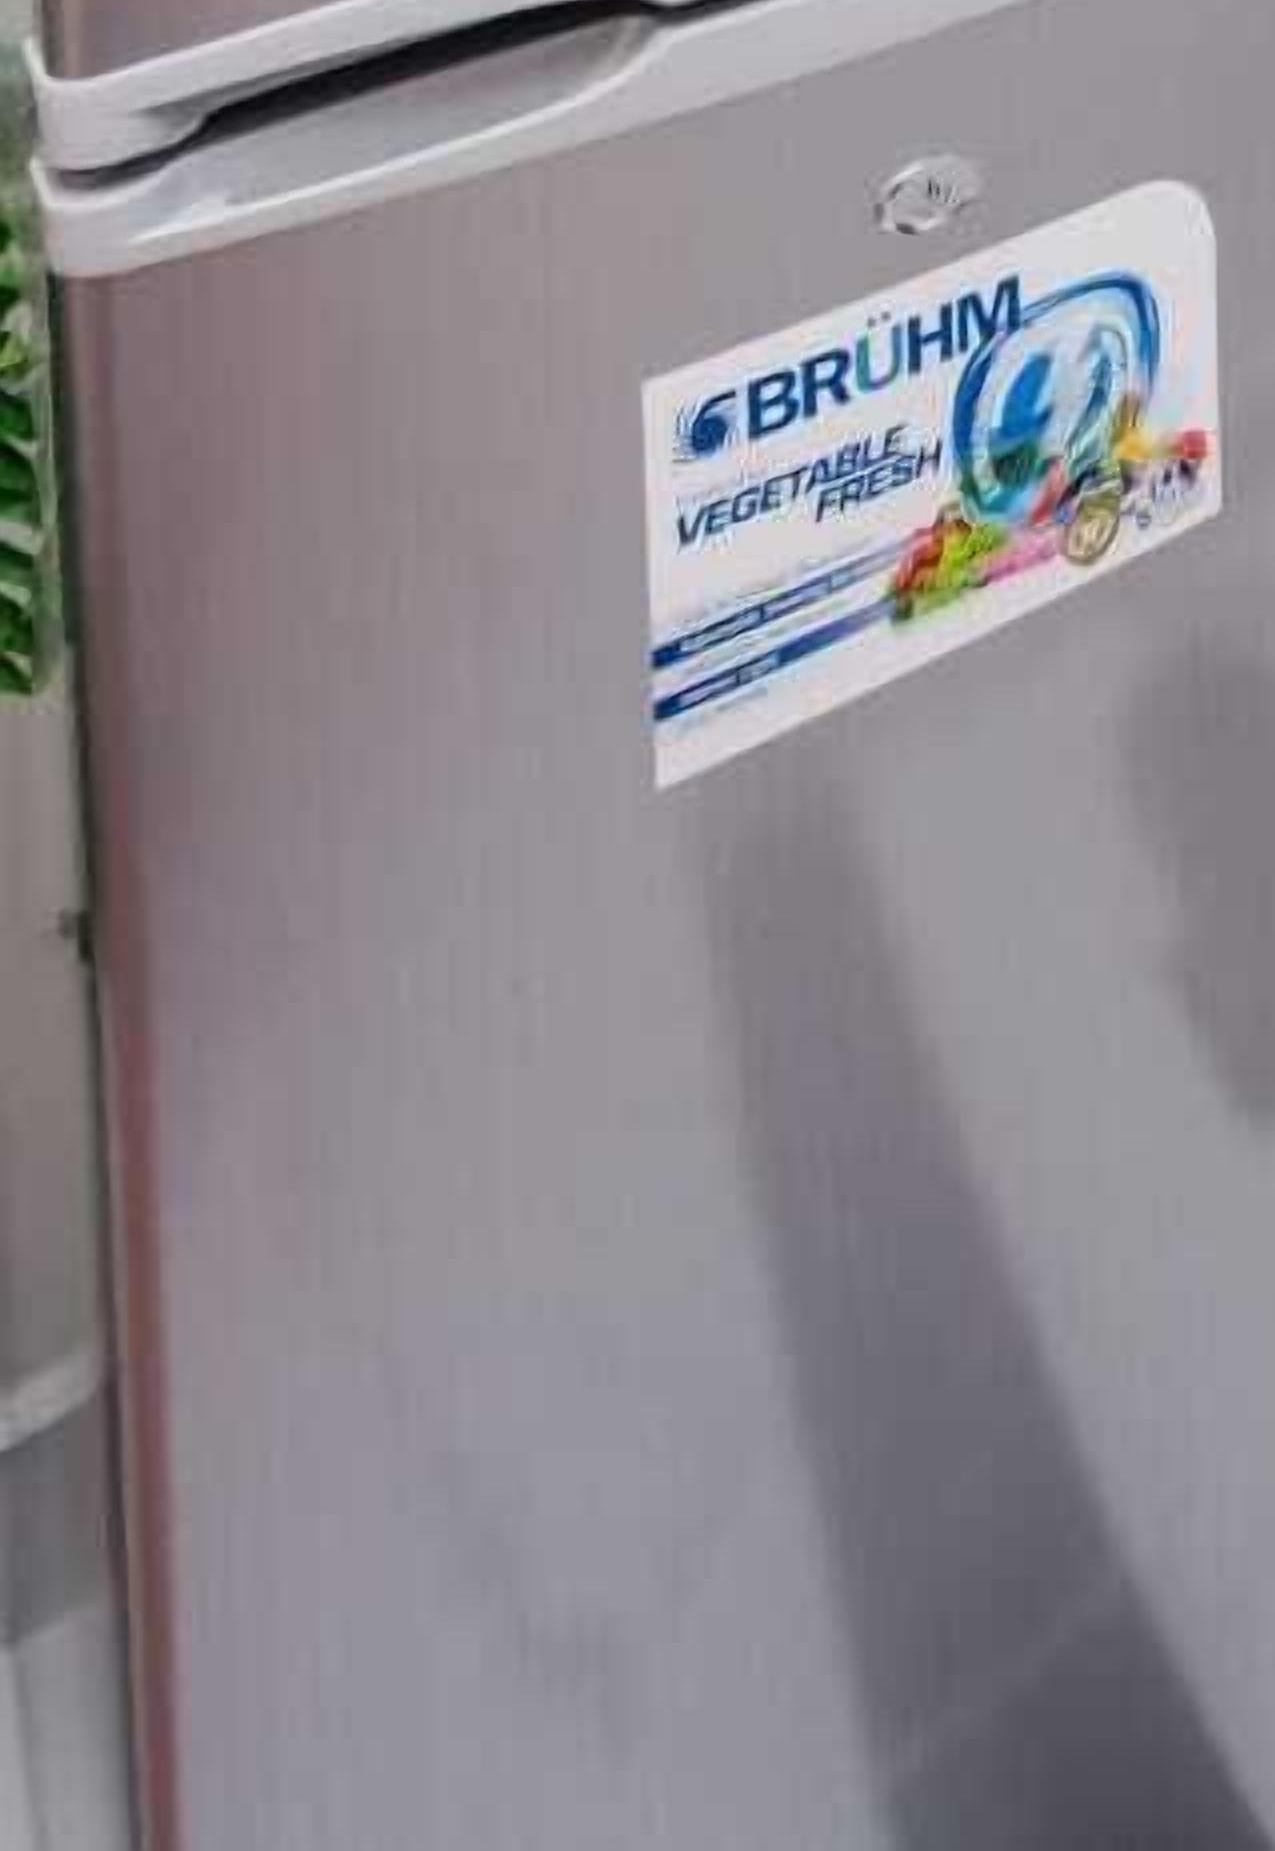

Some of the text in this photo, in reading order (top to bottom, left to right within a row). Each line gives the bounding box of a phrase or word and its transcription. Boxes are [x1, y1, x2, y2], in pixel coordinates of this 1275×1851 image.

[747, 274, 1021, 441] BRÜHM
[677, 425, 907, 545] VEGETABLE
[815, 439, 943, 523] FRESH
